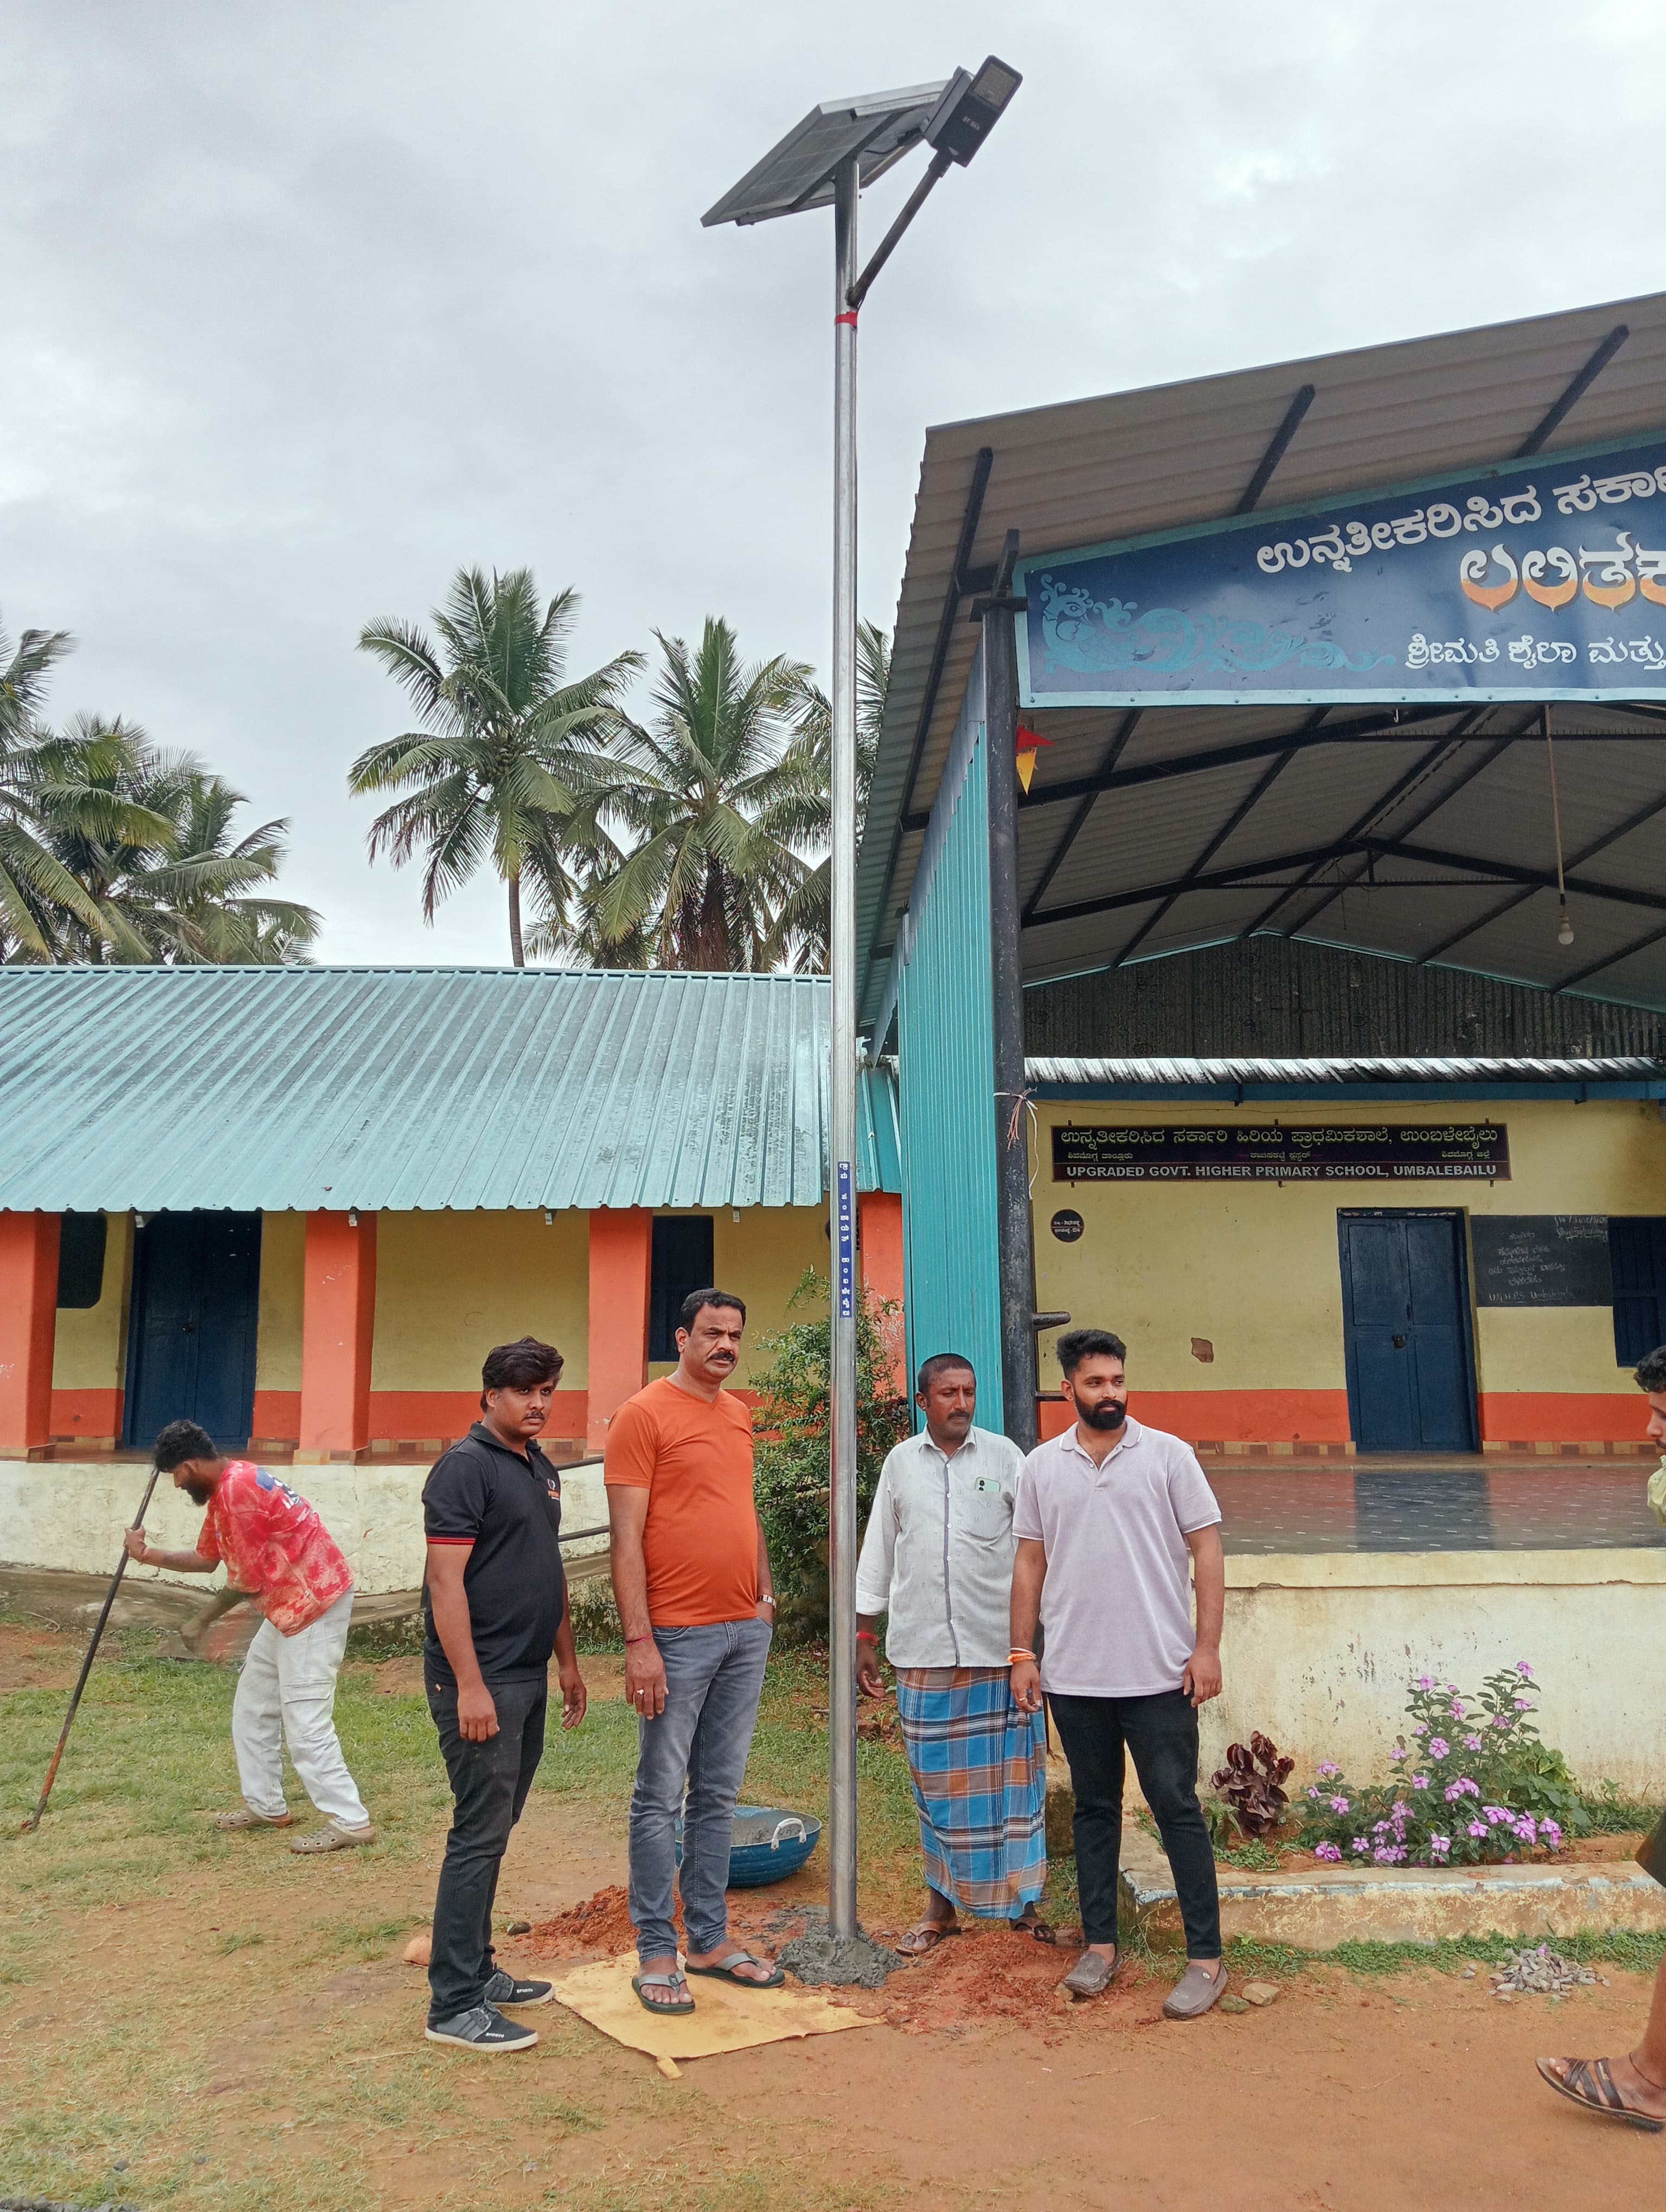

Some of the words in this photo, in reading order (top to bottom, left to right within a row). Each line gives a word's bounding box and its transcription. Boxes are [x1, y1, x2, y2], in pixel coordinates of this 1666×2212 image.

[1257, 485, 1542, 573] ಉನ್ನತೀಕರಿಸಿದ
[1405, 633, 1501, 669] ಶ್ರೀಮತಿ
[1508, 635, 1577, 669] ಶೈಲಾ
[1587, 635, 1666, 670] ಮತ್ತು
[1173, 1129, 1228, 1144] ಸರ್ಕಾರಿ
[1236, 1128, 1283, 1143] ಹಿರಿಯ
[1067, 1166, 1145, 1177] UPGRADED
[1149, 1166, 1191, 1176] GOVT.
[1195, 1166, 1251, 1176] HIGHER
[1255, 1166, 1321, 1176] PRIMARY
[1325, 1165, 1389, 1178] SCHOOL,
[1394, 1165, 1496, 1176] UMBALEBAILU
